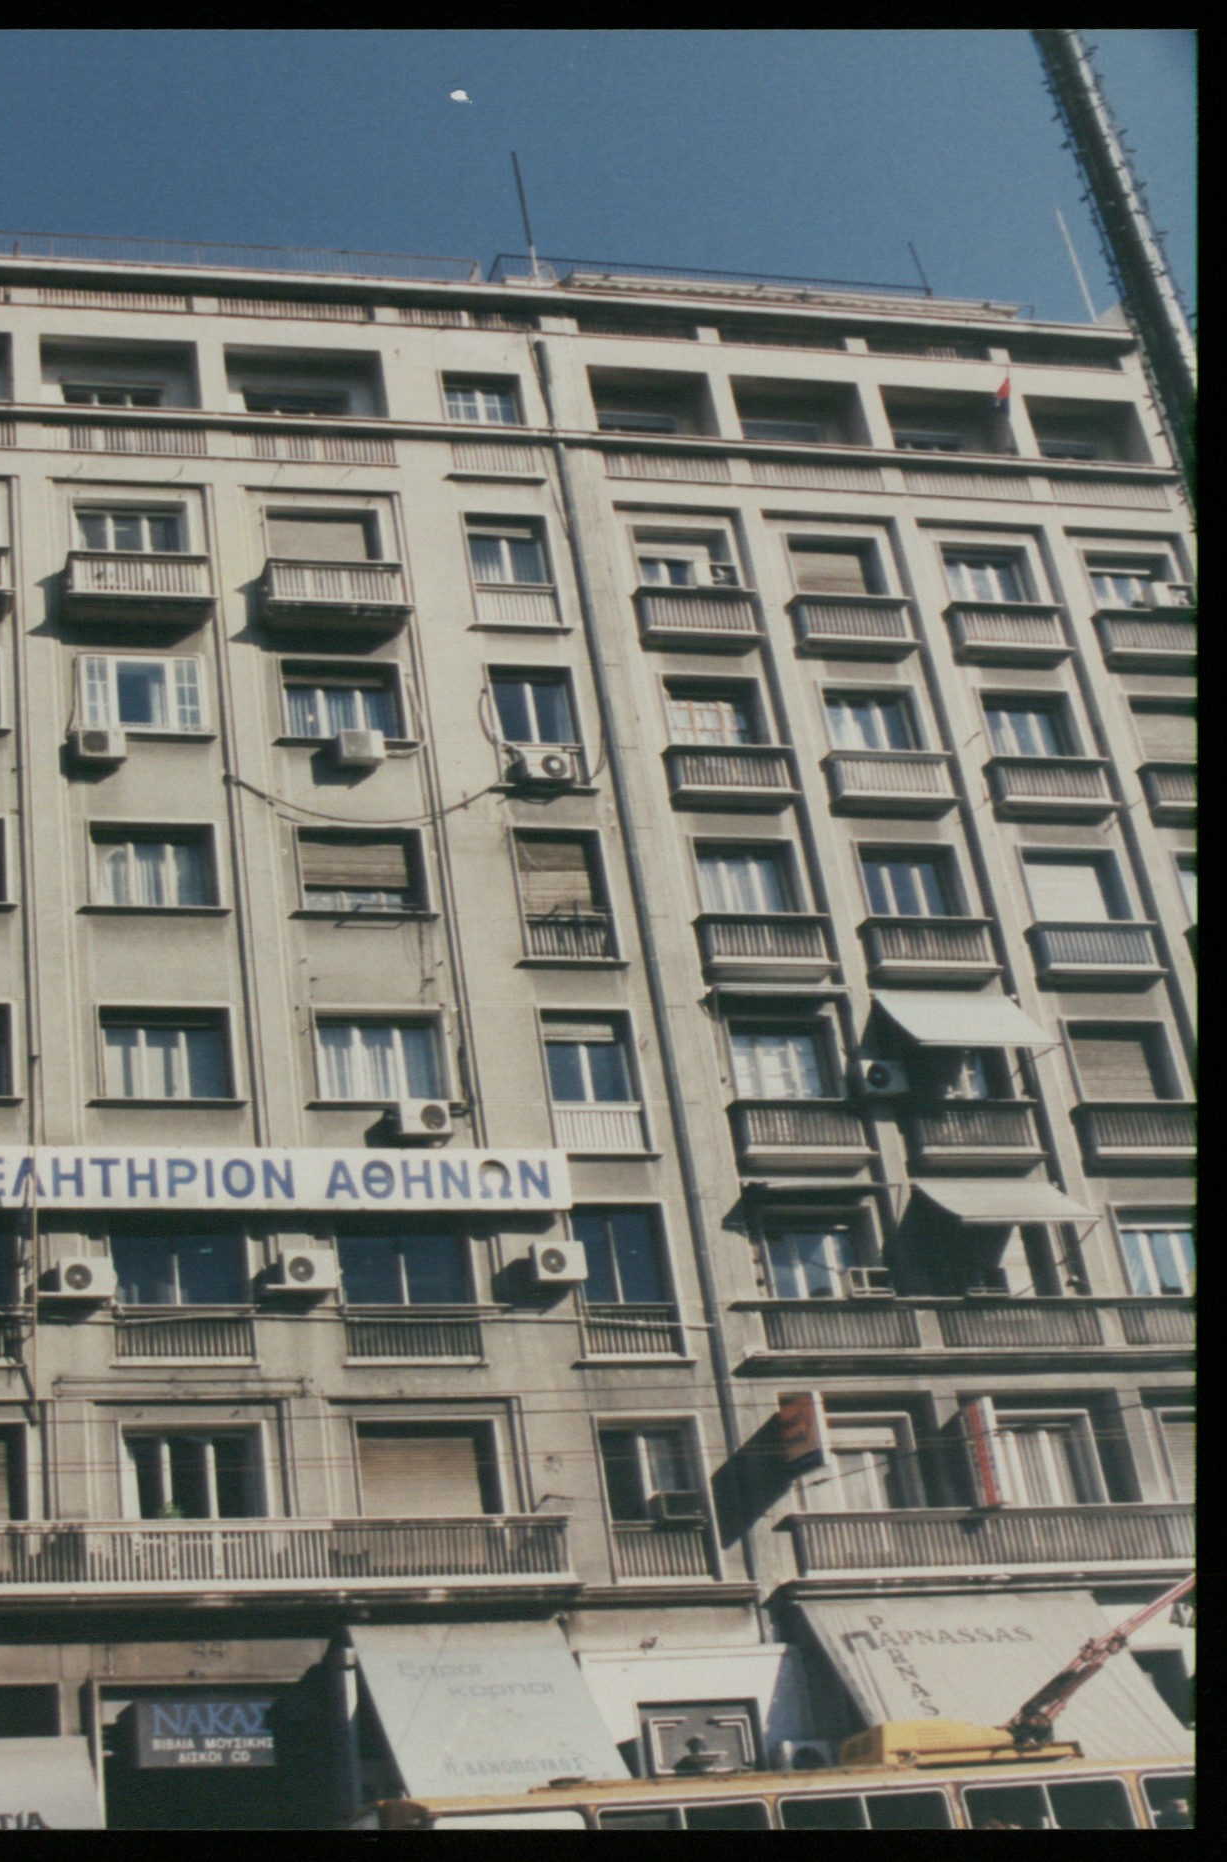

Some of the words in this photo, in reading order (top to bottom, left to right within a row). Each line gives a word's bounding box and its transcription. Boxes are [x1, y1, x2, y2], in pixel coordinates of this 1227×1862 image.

[325, 1159, 552, 1200] ΑΘΗΝΩΝ
[151, 1702, 273, 1736] ΝΑΚΑΣ
[152, 1738, 195, 1750] ΒΙΒΛΙΑ
[204, 1736, 274, 1749] ΜΟΥΣΙΚΗΣ
[178, 1751, 223, 1763] ΔΙΣΚΟΙ
[231, 1750, 251, 1763] CD
